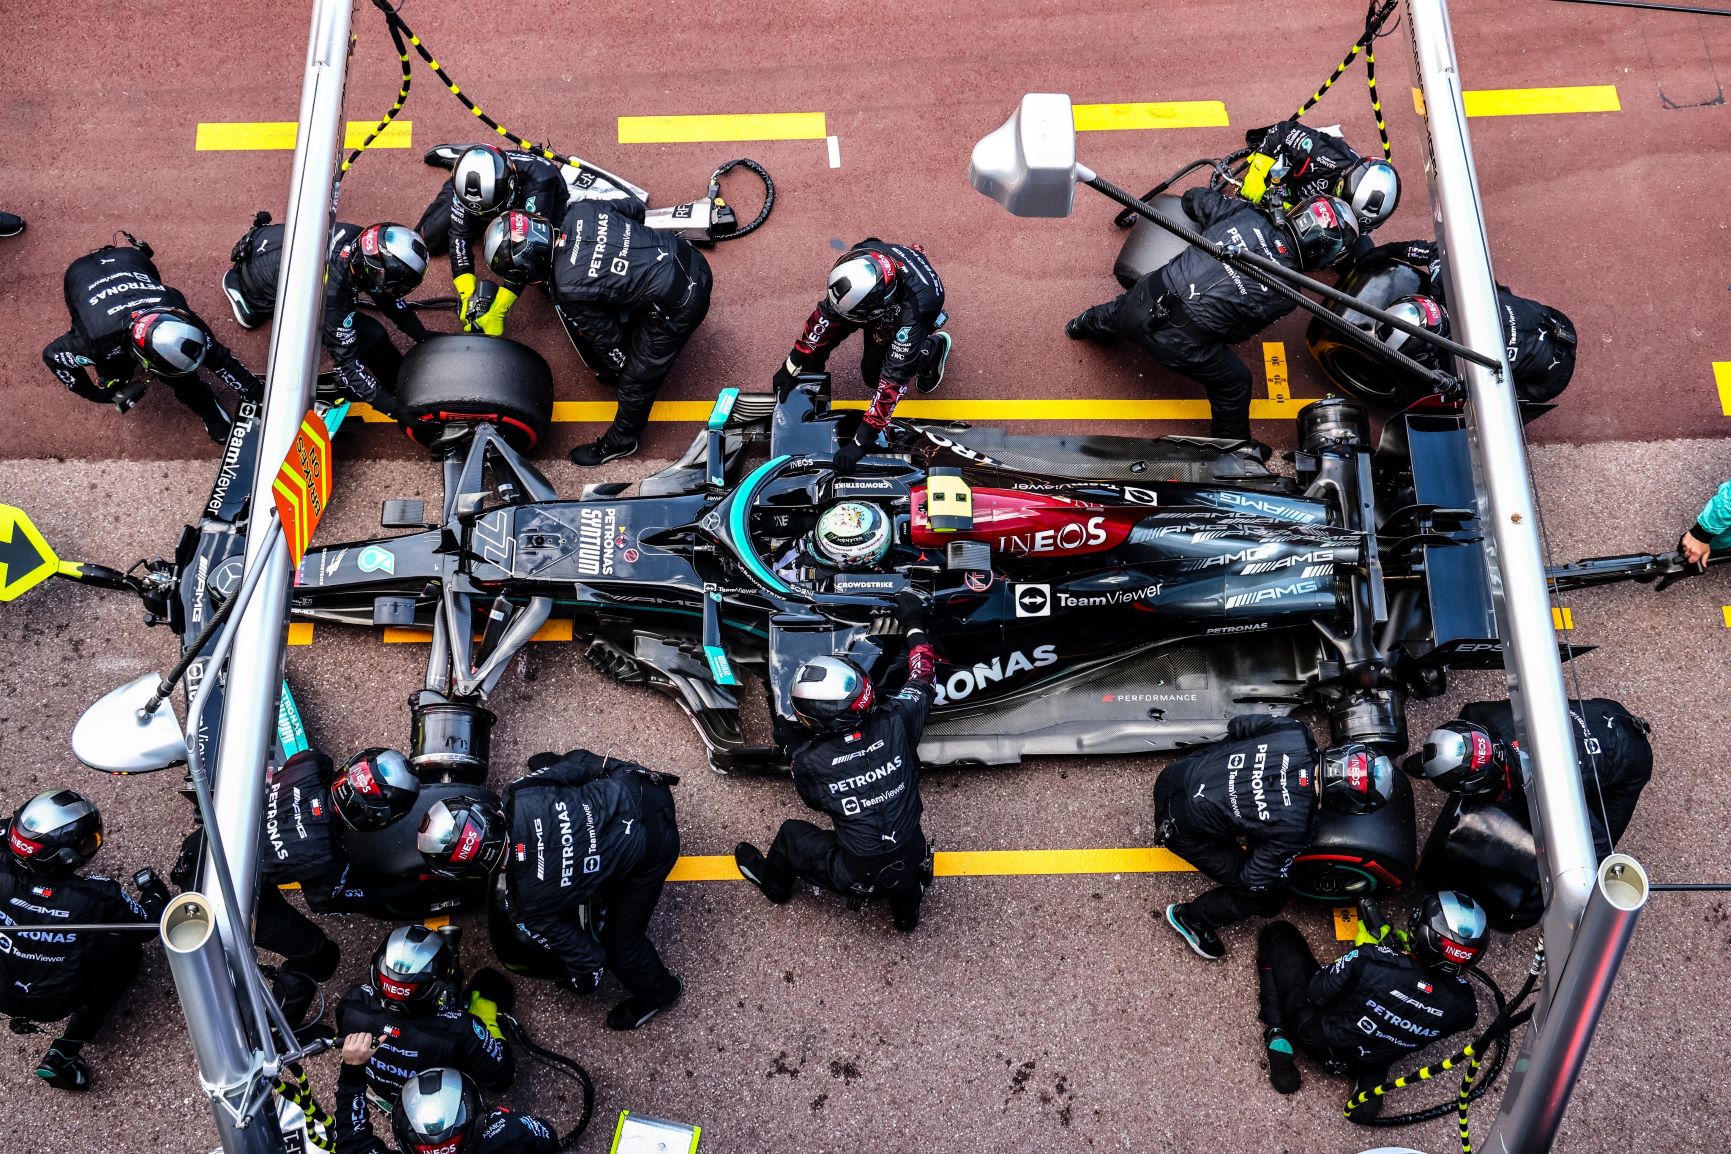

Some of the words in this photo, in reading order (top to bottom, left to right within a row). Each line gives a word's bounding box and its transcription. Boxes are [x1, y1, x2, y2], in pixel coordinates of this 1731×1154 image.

[515, 213, 524, 234] INEOS
[1317, 202, 1331, 225] INEOS
[588, 213, 609, 278] PETRONAS
[619, 222, 632, 258] TeamViewer
[878, 253, 893, 277] INEOS
[89, 282, 166, 307] PETRONAS
[1424, 298, 1439, 319] INEOS
[806, 316, 830, 350] INEOS
[205, 419, 252, 516] TeamViewer
[310, 447, 321, 478] ON
[790, 458, 814, 469] INEOS
[296, 436, 320, 517] BRAKES
[834, 481, 893, 490] CROWDSTRIKE
[476, 510, 516, 575] 77
[578, 508, 602, 575] SYNTIUM
[603, 508, 616, 576] PETRONAS
[998, 516, 1106, 553] INEOS
[790, 583, 814, 597] INEOS
[837, 581, 894, 589] CROWDSTRIKE
[1056, 583, 1163, 607] TeamViewer
[1207, 622, 1268, 635] PETRONAS
[858, 684, 872, 710] INEOS
[1117, 694, 1198, 702] PERFORMANCE
[1477, 737, 1486, 764] INEOS
[353, 767, 372, 793] INEOS
[828, 756, 902, 794] PETRONAS
[1251, 743, 1270, 821] PETRONAS
[1351, 758, 1361, 786] INEOS
[860, 782, 905, 808] TeamViewer
[1228, 769, 1242, 819] TeamViewer
[267, 782, 289, 860] PETRONAS
[581, 803, 597, 855] TeamViewer
[11, 834, 34, 854] INEOS
[459, 830, 477, 860] INEOS
[555, 801, 572, 888] PETRONAS
[13, 946, 66, 963] TeamViewer
[1445, 945, 1473, 961] INEOS
[383, 981, 411, 996] INEOS
[1365, 999, 1440, 1038] PETRONAS
